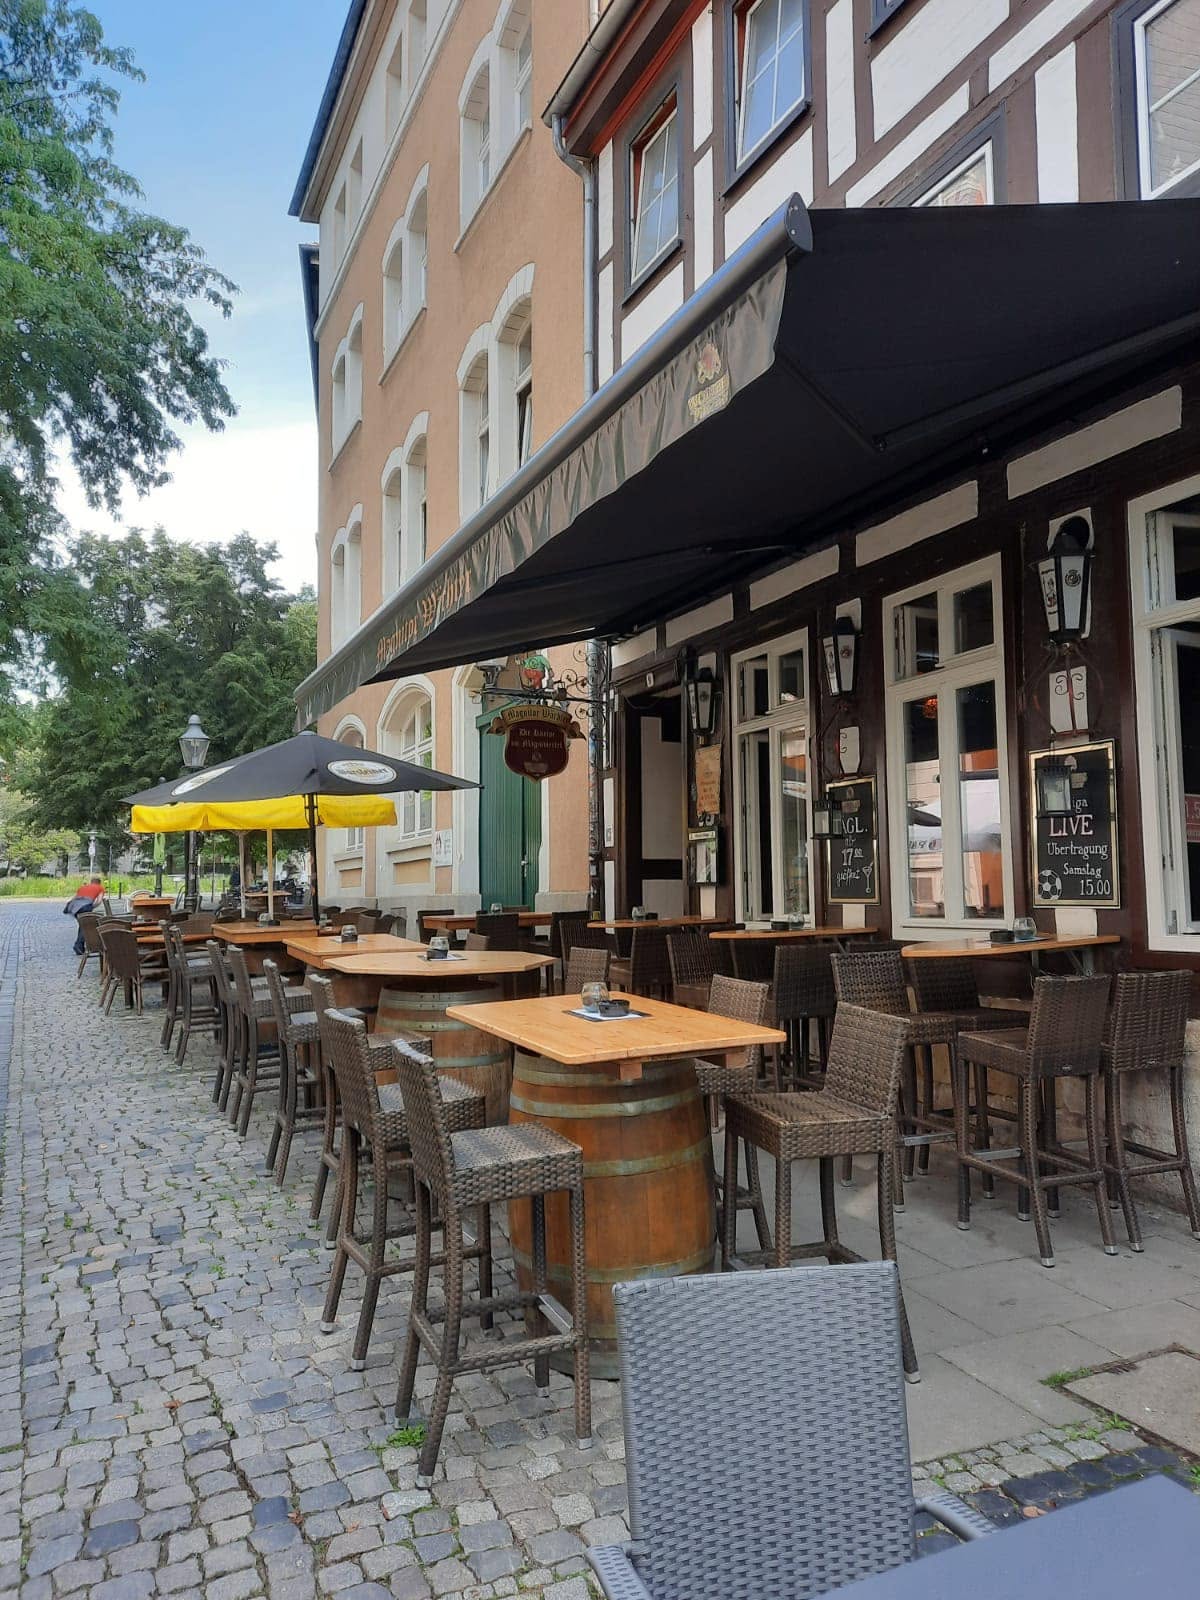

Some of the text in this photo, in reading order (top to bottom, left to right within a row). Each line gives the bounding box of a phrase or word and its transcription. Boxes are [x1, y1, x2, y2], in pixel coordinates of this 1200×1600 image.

[1048, 814, 1093, 836] LIVE
[1063, 862, 1102, 879] Samstag
[1080, 879, 1111, 896] 15.00
